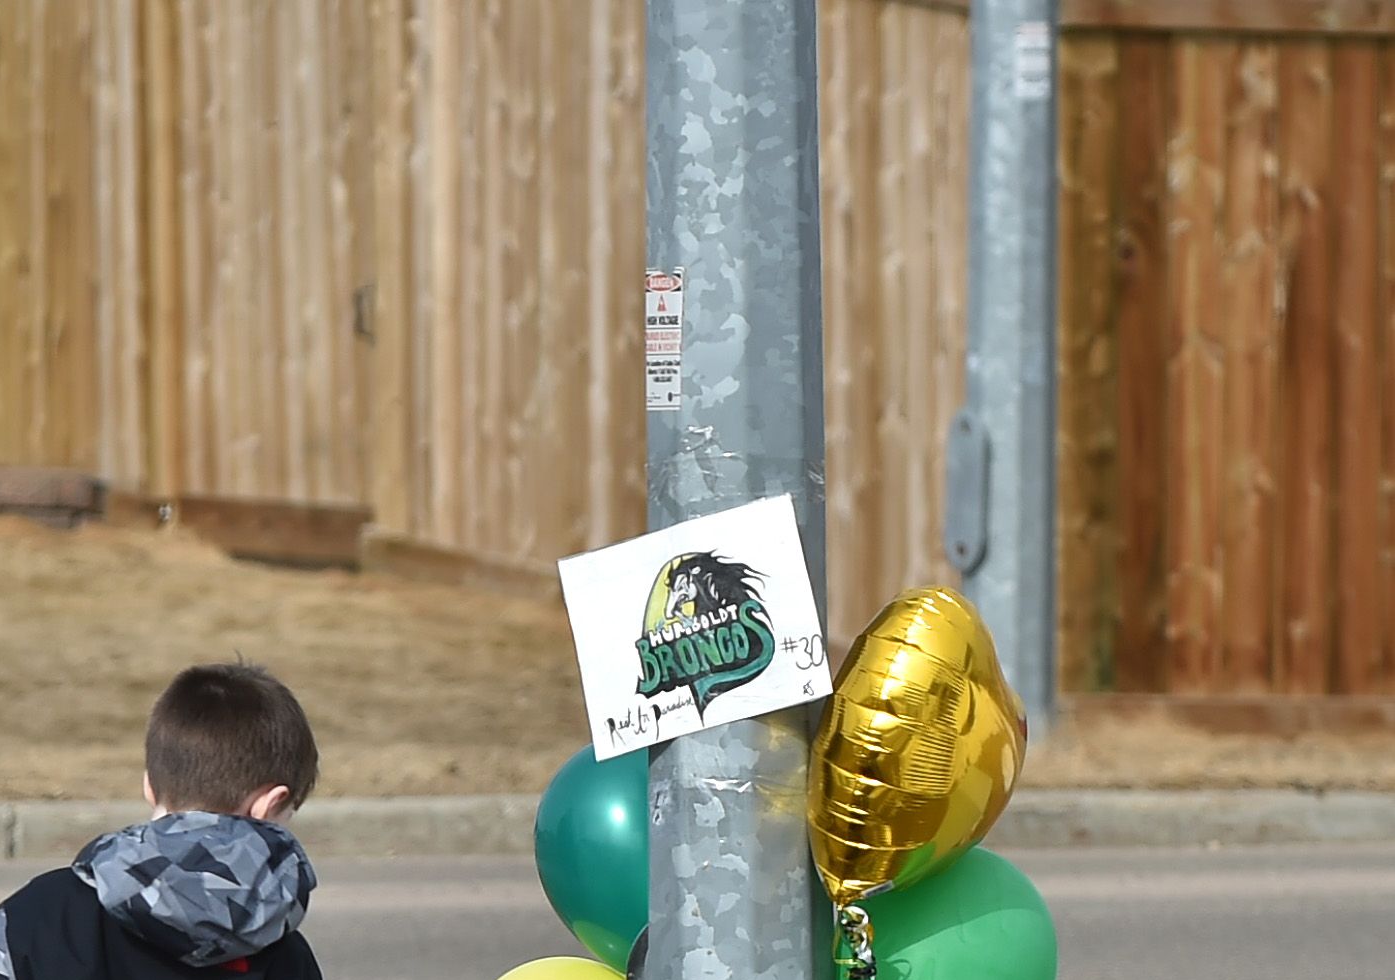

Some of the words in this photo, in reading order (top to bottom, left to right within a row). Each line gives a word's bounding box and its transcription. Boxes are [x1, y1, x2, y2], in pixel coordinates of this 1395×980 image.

[647, 603, 739, 647] HUMBOLDT
[635, 598, 776, 699] BRONCOS
[779, 633, 825, 670] #30
